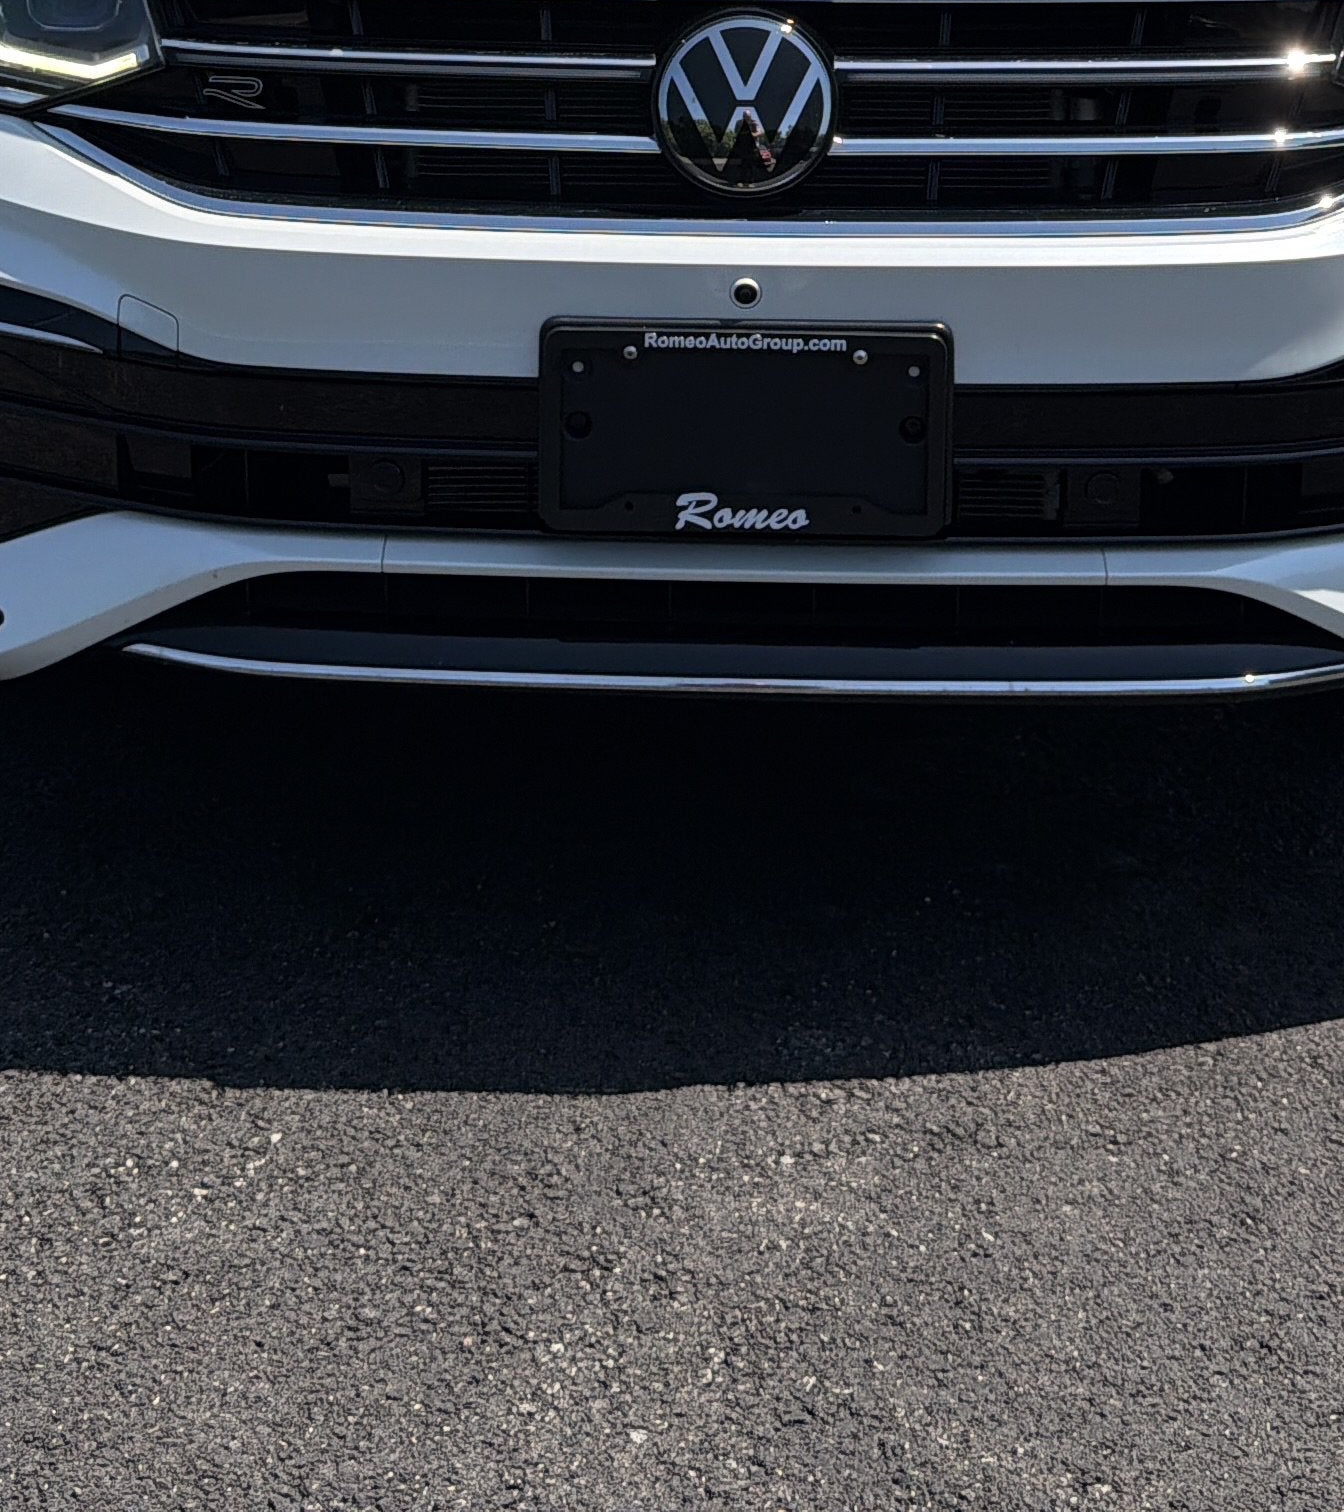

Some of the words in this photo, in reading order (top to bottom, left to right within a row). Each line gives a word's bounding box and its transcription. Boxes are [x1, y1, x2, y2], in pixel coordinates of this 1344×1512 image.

[203, 75, 266, 110] R
[657, 14, 832, 192] VW
[644, 332, 848, 353] RomeoAutoGroup.com
[675, 492, 810, 530] Romeo
